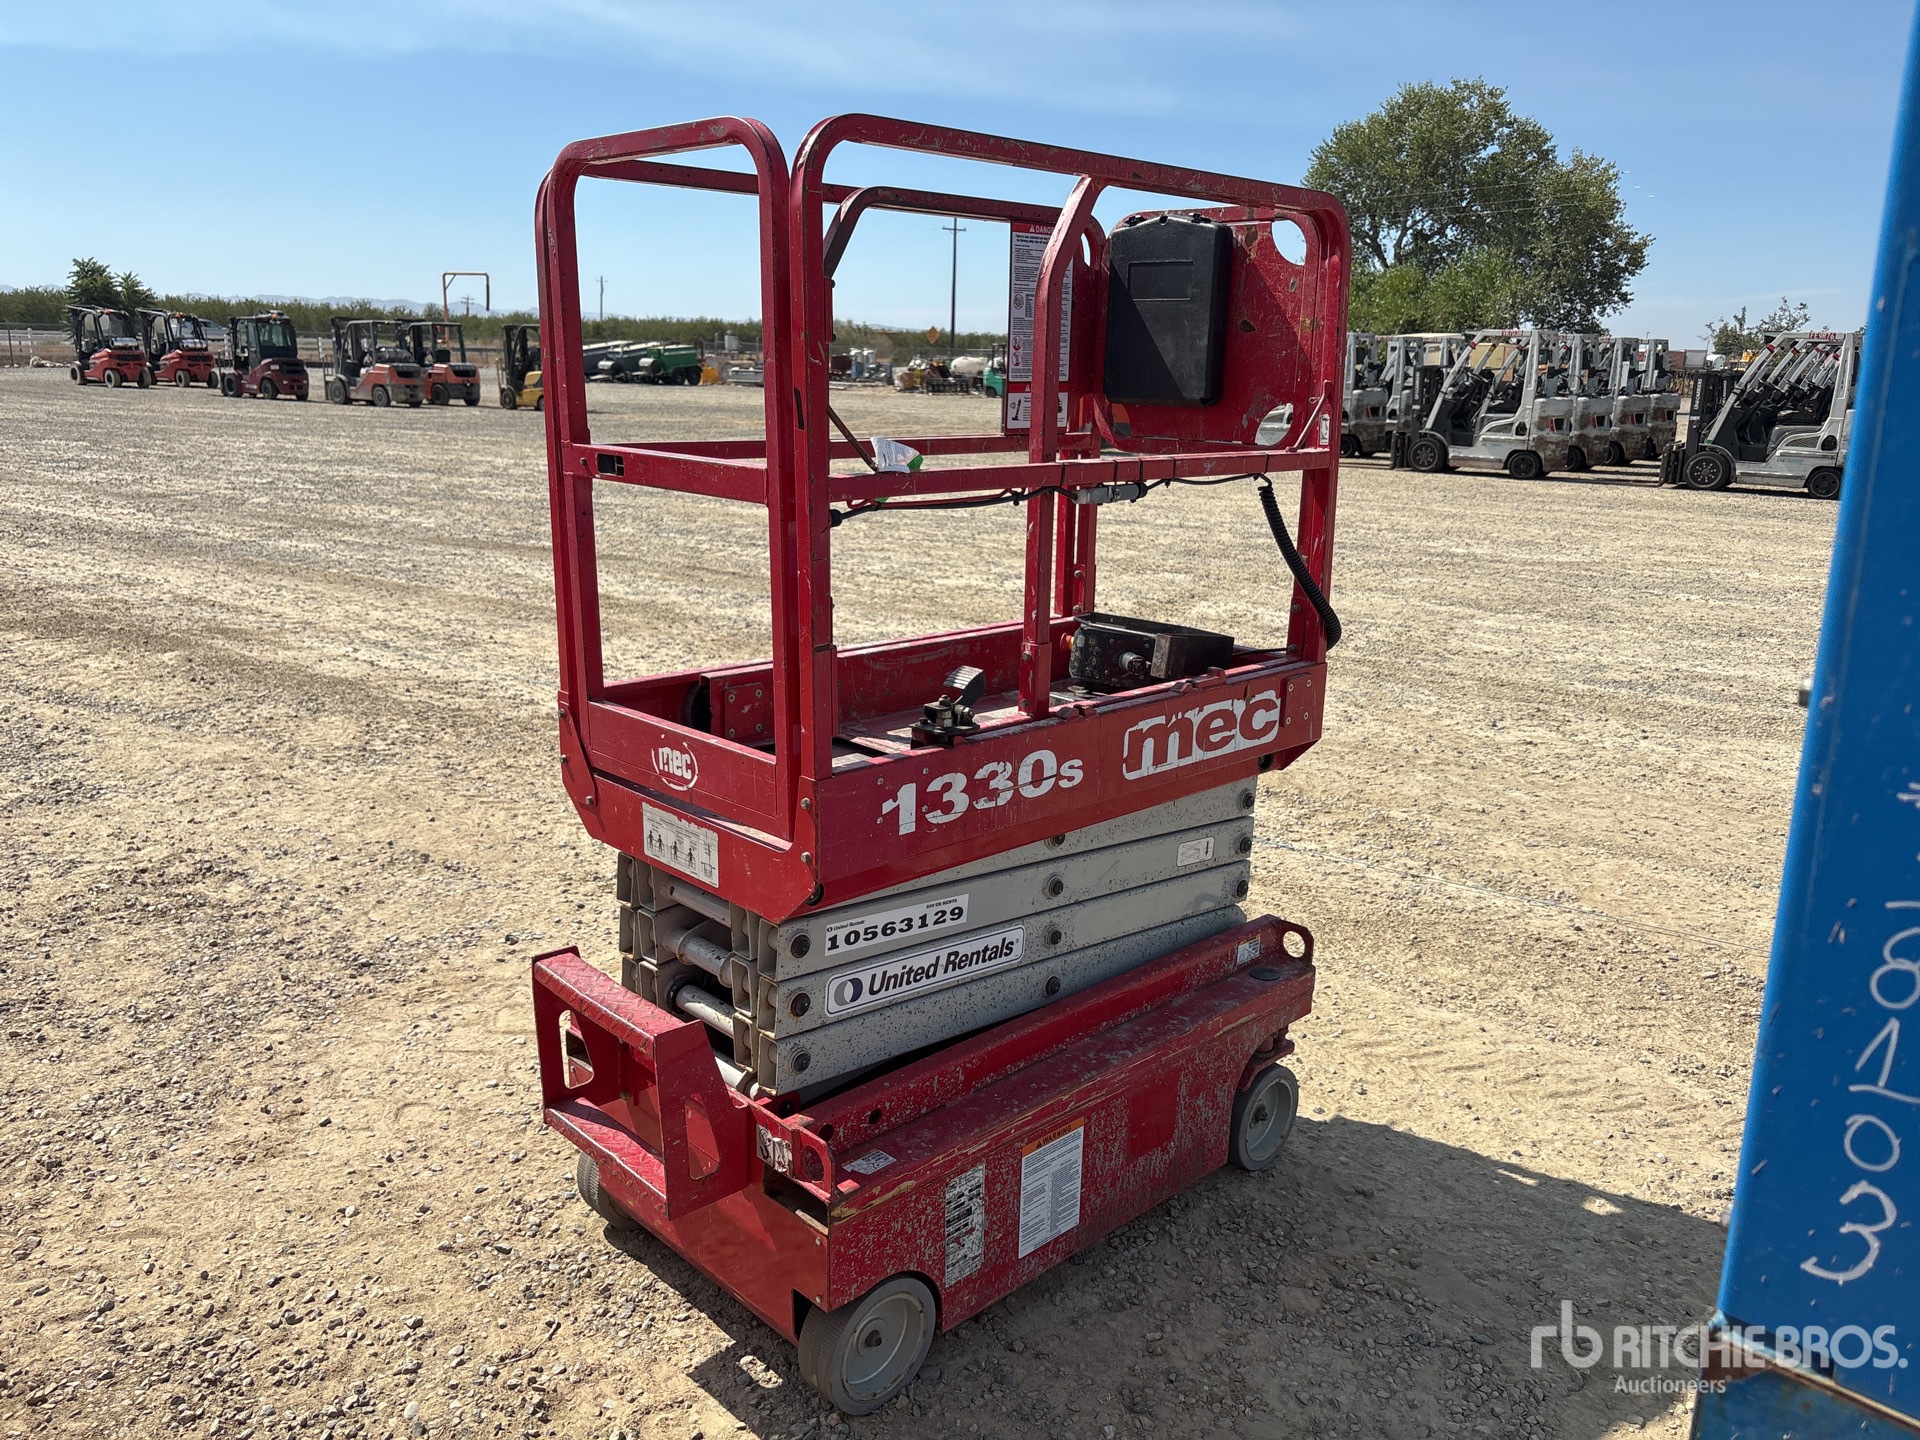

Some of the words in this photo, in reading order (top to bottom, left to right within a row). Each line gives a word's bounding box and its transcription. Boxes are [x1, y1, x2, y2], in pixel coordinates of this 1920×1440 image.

[827, 906, 964, 951] 10563129
[868, 955, 941, 997] United
[943, 936, 1016, 974] Rentals
[1042, 1124, 1072, 1145] WARNING
